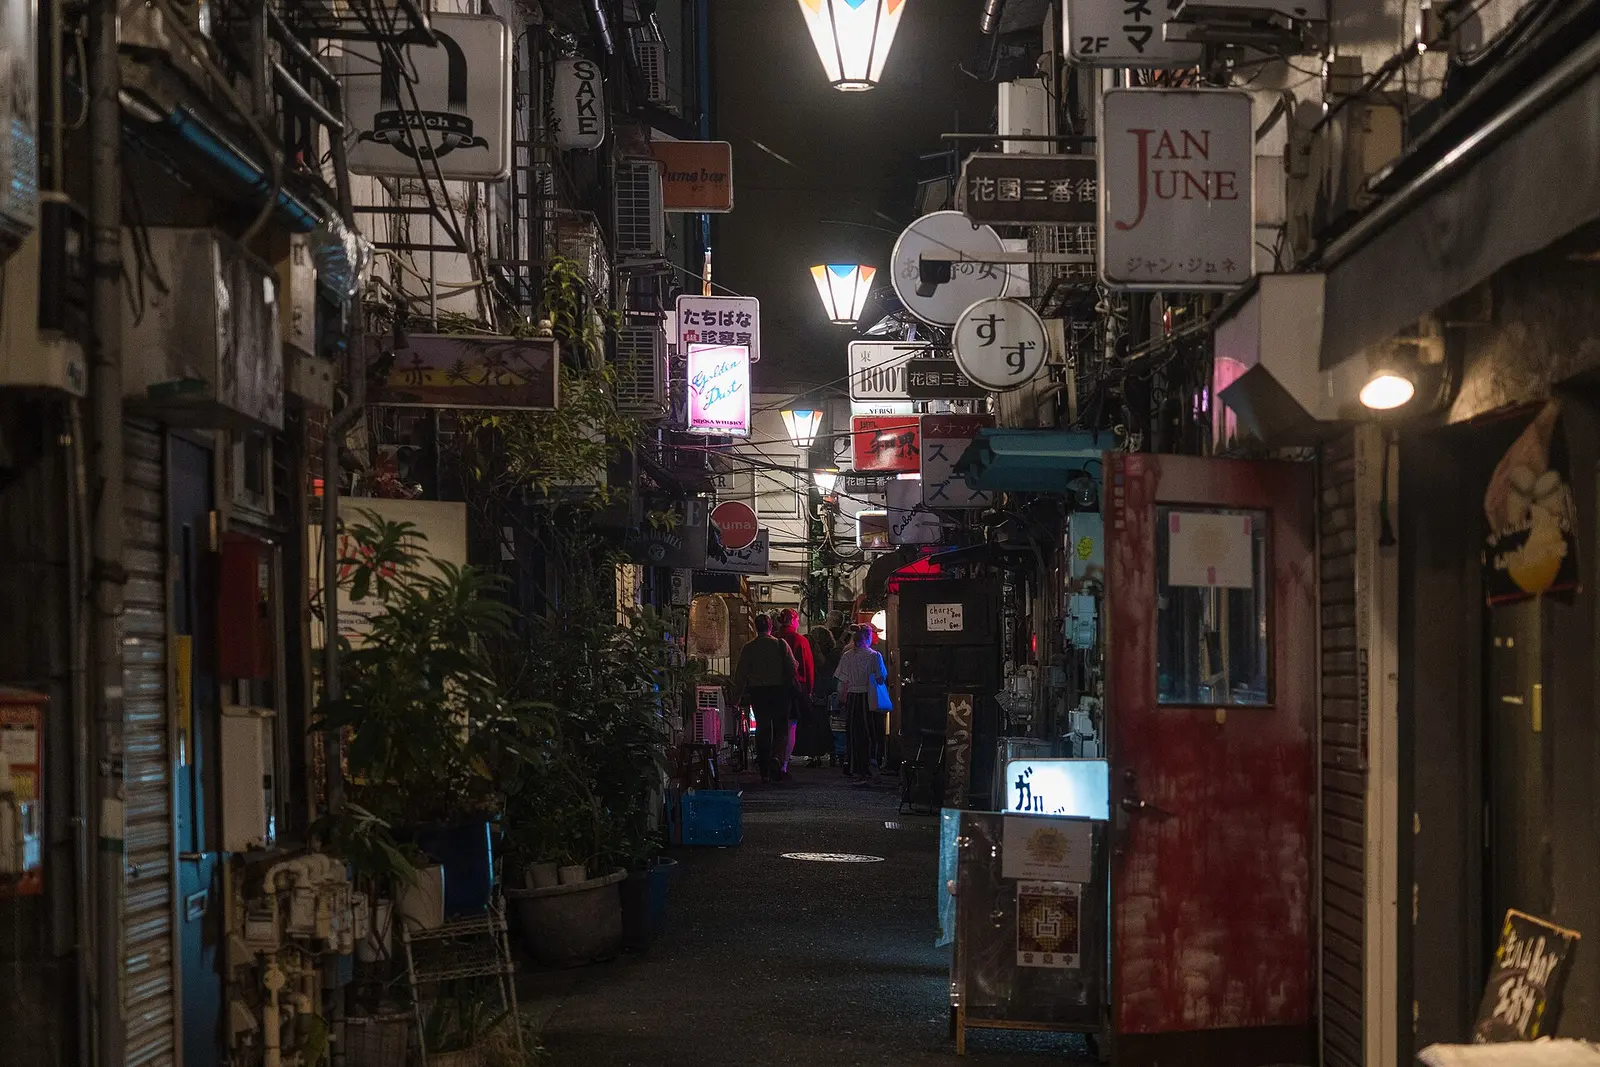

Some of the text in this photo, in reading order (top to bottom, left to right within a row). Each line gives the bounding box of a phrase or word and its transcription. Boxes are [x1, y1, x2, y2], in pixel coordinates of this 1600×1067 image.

[1080, 36, 1109, 54] 2F
[573, 61, 598, 134] SAKE
[968, 175, 1098, 203] 花園三番街
[1126, 257, 1237, 273] ジャン・ジュネ
[683, 308, 752, 328] たちばな
[970, 313, 1036, 377] すず
[703, 379, 743, 410] Dust
[716, 418, 743, 426] WHISKY
